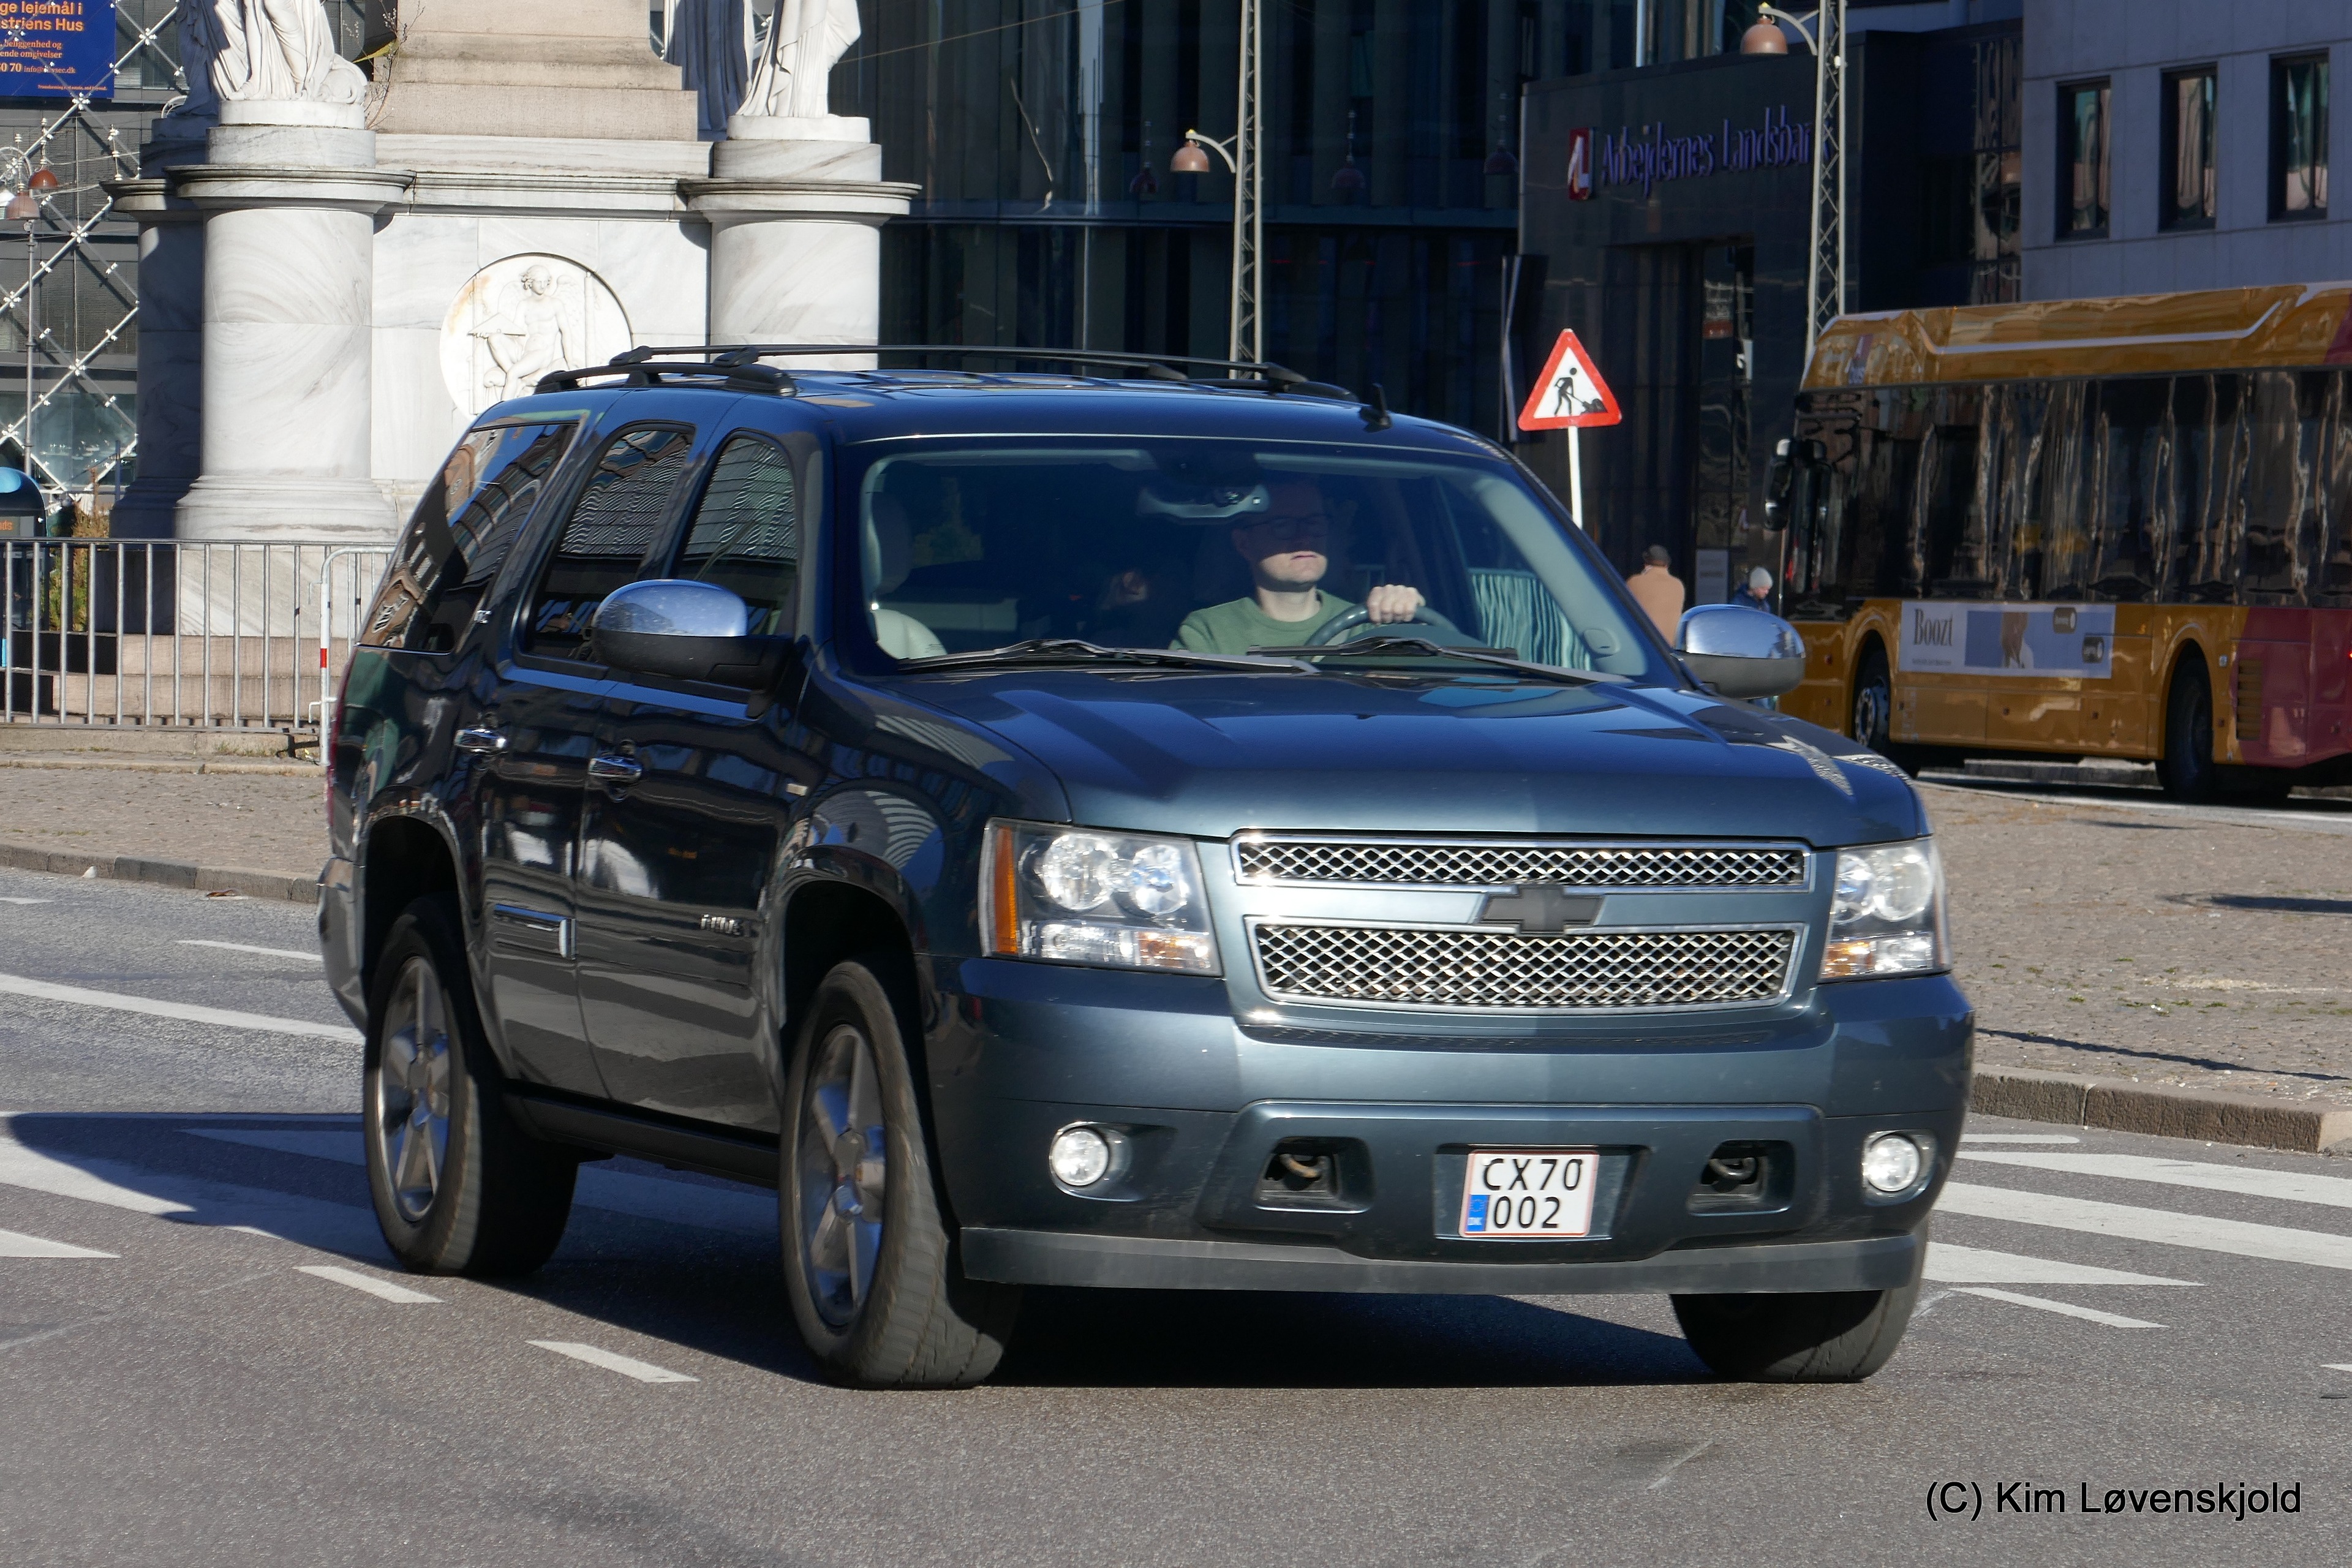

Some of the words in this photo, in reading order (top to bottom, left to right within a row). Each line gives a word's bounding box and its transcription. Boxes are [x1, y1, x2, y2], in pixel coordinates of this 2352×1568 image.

[78, 2, 83, 15] i
[56, 18, 85, 31] Hus
[20, 50, 62, 59] omgivelser
[9, 63, 22, 72] 70
[1601, 121, 1714, 199] Arbejdernes
[1494, 1196, 1560, 1229] 002
